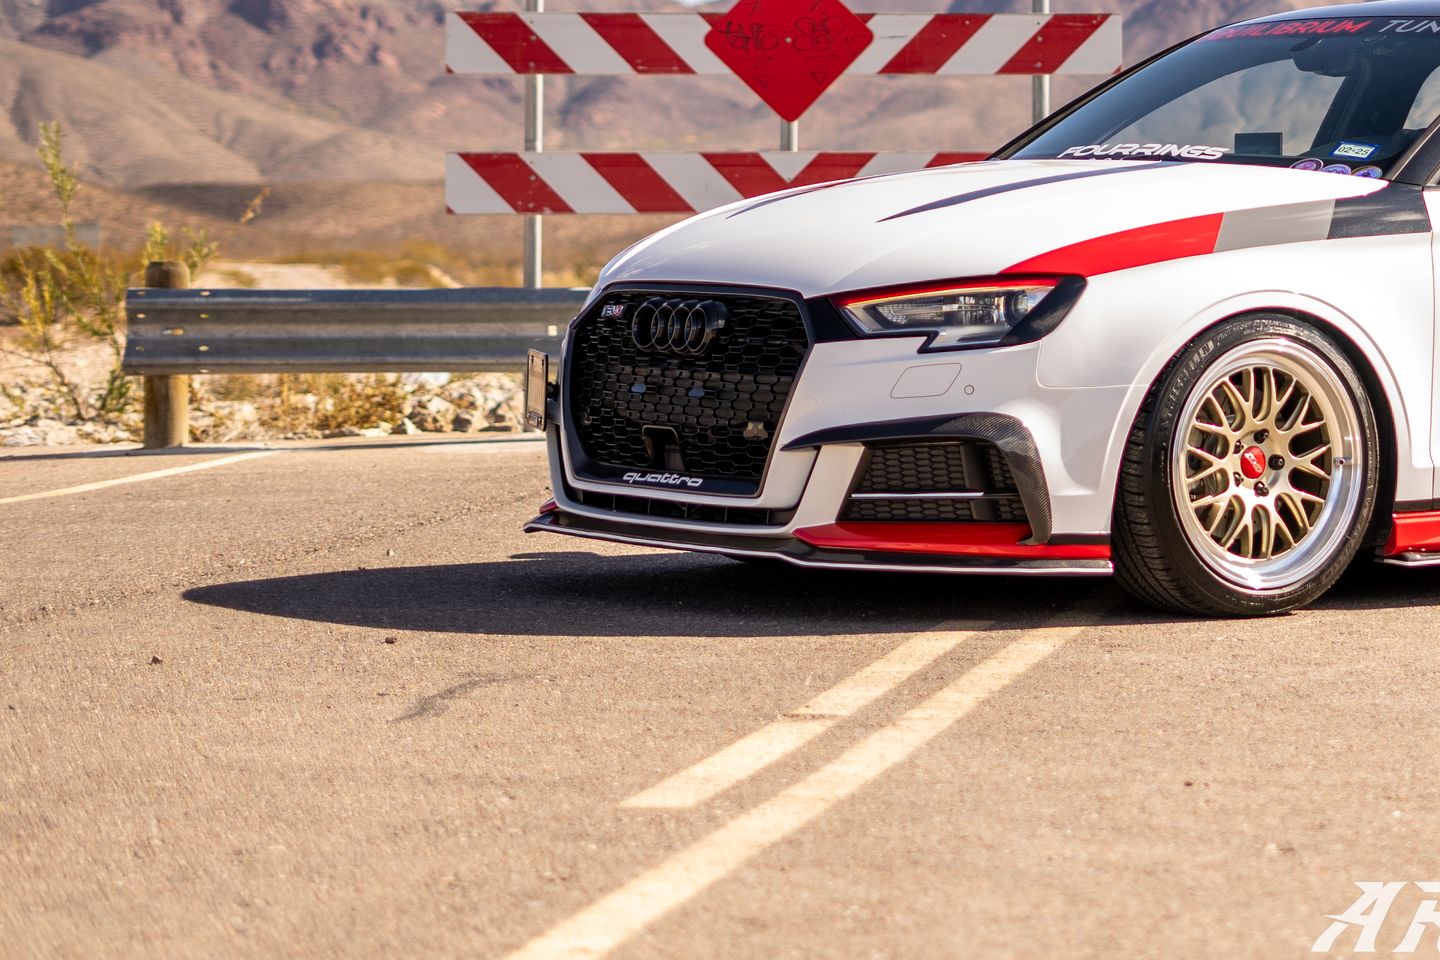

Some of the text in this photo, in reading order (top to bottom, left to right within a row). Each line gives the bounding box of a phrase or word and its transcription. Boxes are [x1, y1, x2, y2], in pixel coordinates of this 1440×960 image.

[1206, 20, 1372, 40] UILIBRIUM
[1057, 143, 1231, 160] FOURRINGS
[622, 472, 704, 487] quattro
